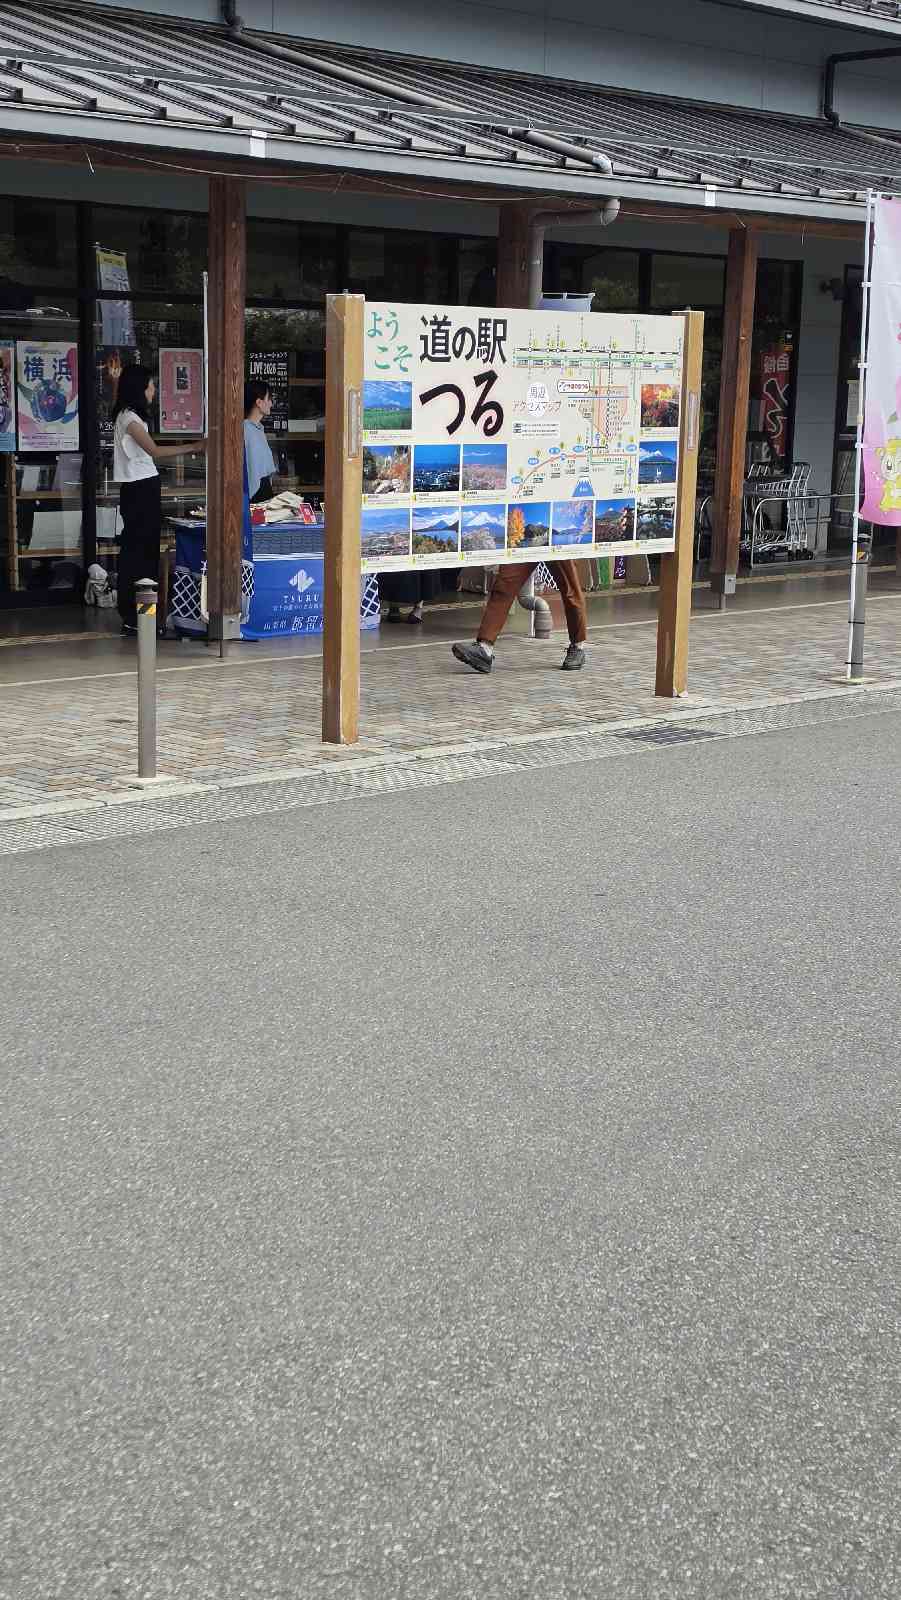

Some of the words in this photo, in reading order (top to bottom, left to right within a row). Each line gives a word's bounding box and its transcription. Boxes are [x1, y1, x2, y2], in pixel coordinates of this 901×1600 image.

[367, 311, 399, 341] よう
[419, 315, 508, 364] 道の駅
[24, 356, 71, 382] 横浜
[250, 361, 263, 375] LIVE
[263, 363, 277, 375] 2026
[374, 345, 413, 372] こそ
[419, 370, 504, 436] つる
